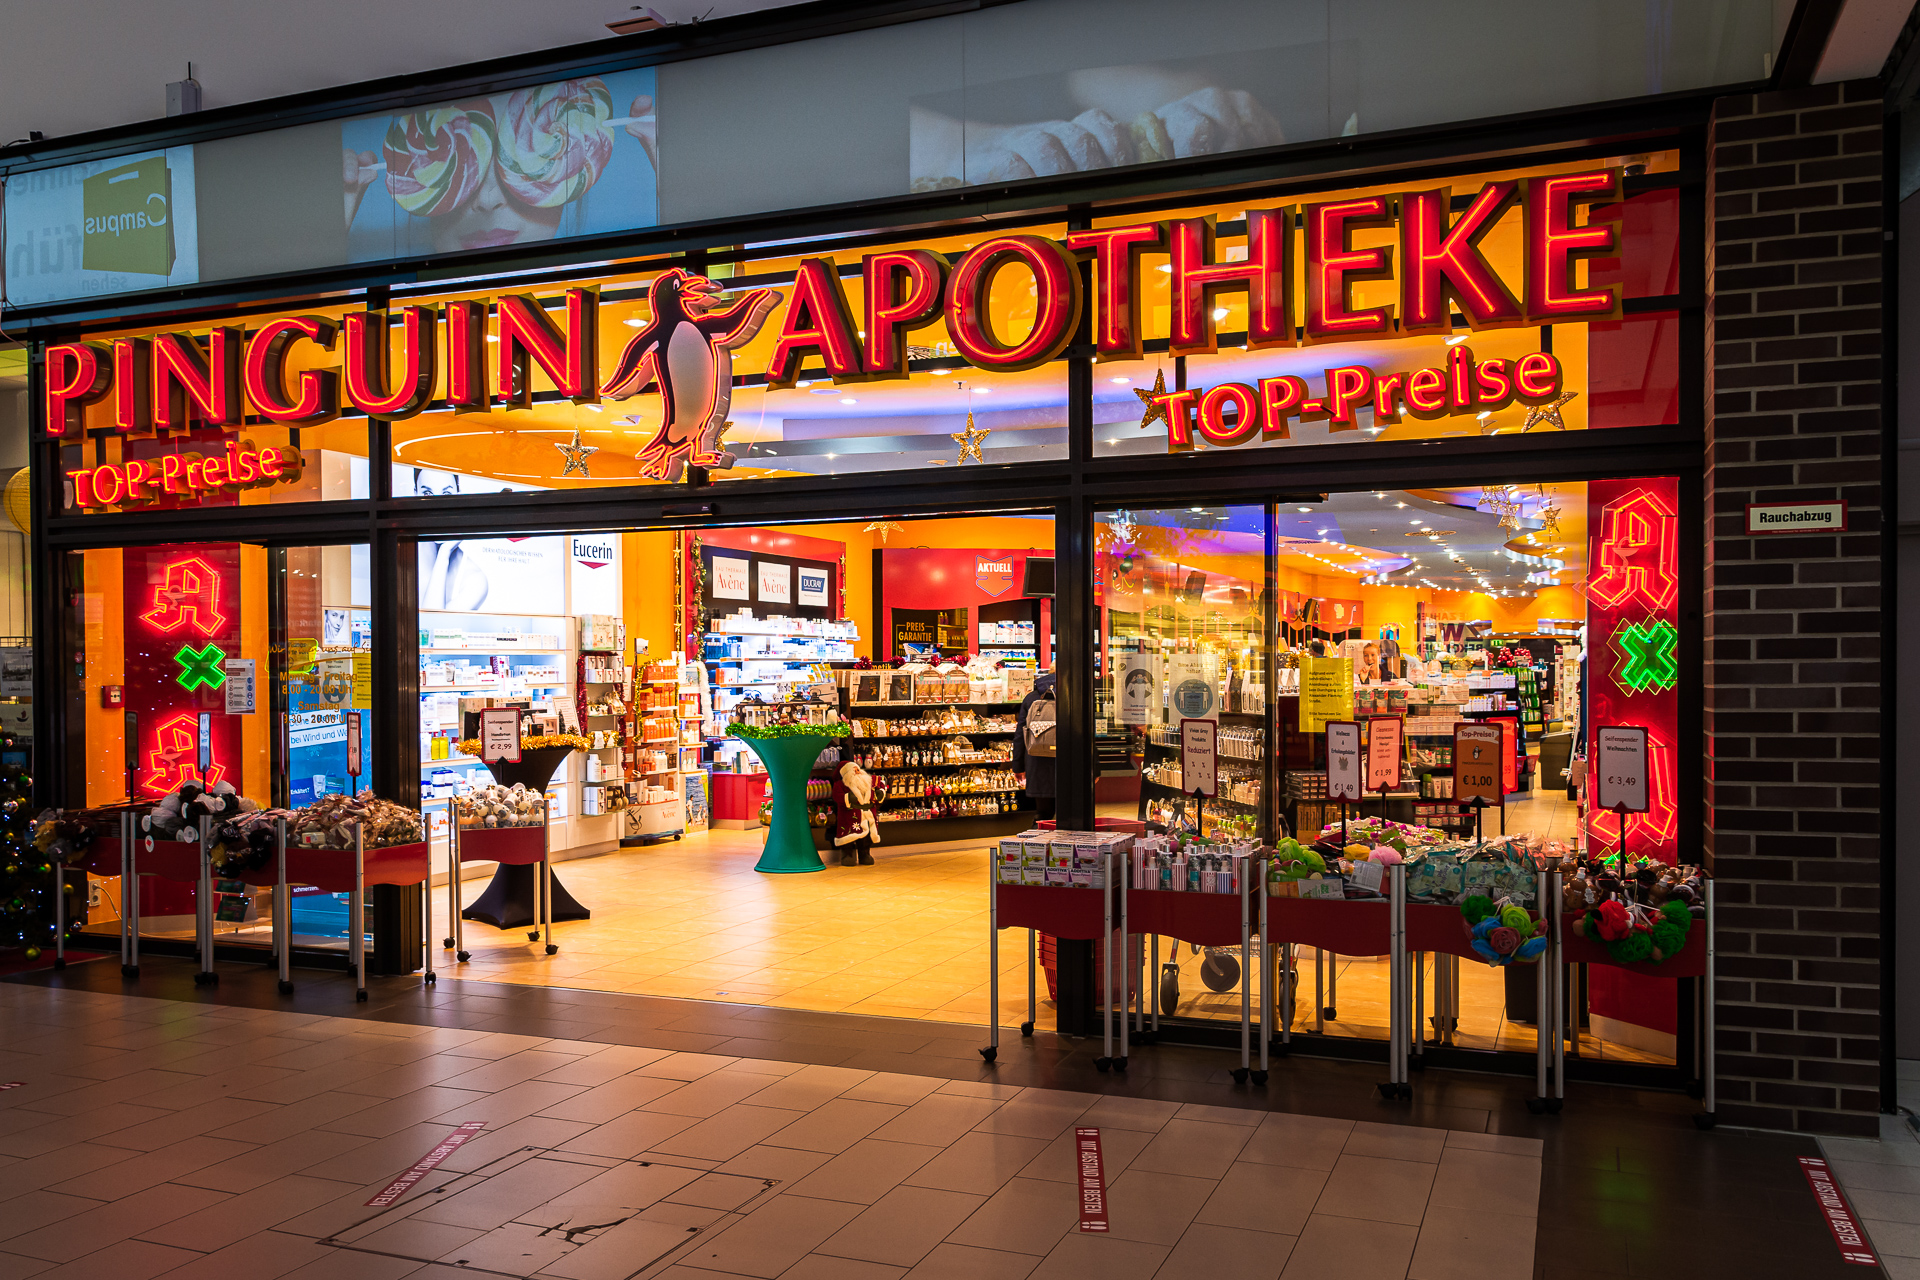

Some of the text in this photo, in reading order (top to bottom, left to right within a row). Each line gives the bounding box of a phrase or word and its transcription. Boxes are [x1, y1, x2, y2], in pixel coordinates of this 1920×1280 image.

[45, 169, 1622, 441] PINGUIN APOTHEKE
[1153, 346, 1560, 453] TOP-Preise
[67, 440, 296, 508] TOP-Preise
[1759, 510, 1832, 523] Rauchabzug
[573, 538, 614, 560] Eucerin
[977, 562, 1012, 573] AKTUELL
[717, 573, 745, 591] Avène
[762, 577, 787, 595] Avène
[803, 578, 823, 588] DUCRAY
[906, 622, 925, 632] PREIS
[898, 631, 932, 642] GARANTIE
[280, 671, 315, 683] Montag
[324, 671, 358, 683] Freitag
[282, 684, 302, 694] 8.00
[310, 684, 335, 694] 20.00
[338, 684, 356, 694] Uhr
[298, 701, 340, 713] Samstag
[310, 714, 336, 724] 20.00
[291, 735, 302, 744] bei
[302, 732, 321, 743] Wind
[322, 730, 336, 739] und
[1461, 730, 1495, 739] Top-Preise!
[1187, 745, 1212, 755] Reduziert
[1375, 768, 1392, 777] € 1,99
[1463, 775, 1492, 788] € 1,00
[1608, 776, 1636, 787] € 3,49
[1334, 783, 1354, 793] € 1,49
[414, 1144, 455, 1170] ABSTAND
[400, 1170, 423, 1181] AM
[1080, 1140, 1102, 1214] MIT ABSTAND AM BESTEN
[369, 1182, 411, 1206] BESTEN
[1808, 1169, 1864, 1246] MIT ABSTAND AM BESTEN
